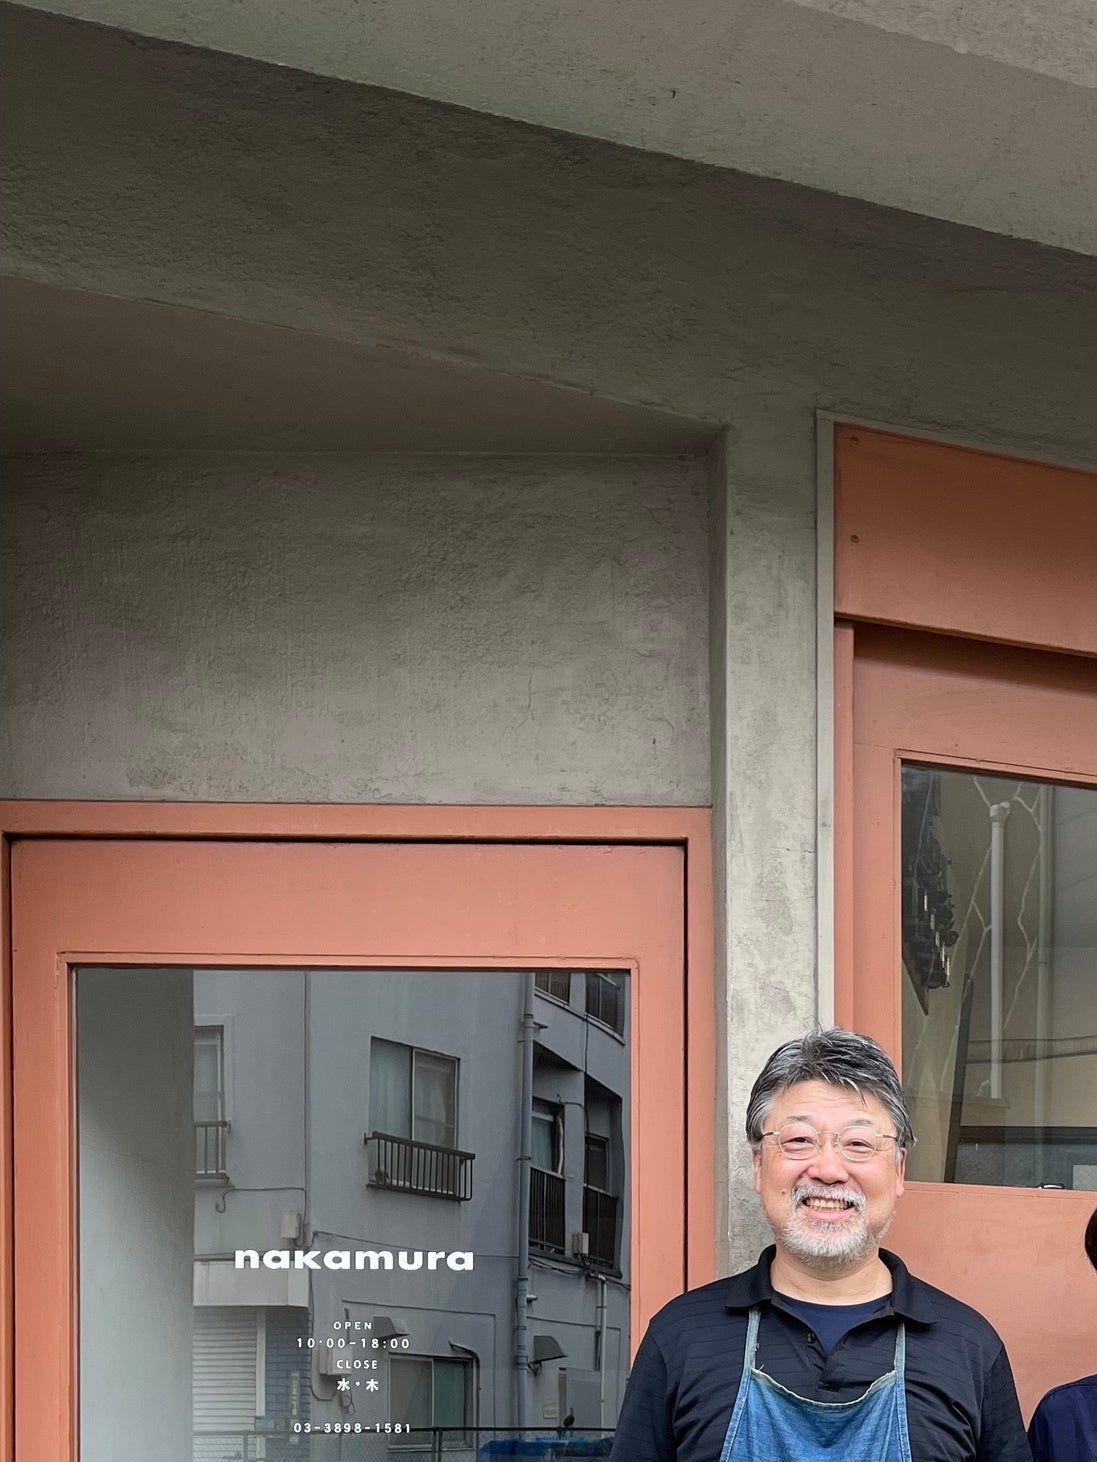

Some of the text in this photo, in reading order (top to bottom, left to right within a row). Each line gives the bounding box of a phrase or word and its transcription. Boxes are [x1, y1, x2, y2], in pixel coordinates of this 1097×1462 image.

[234, 1249, 475, 1271] nakamura
[333, 1321, 372, 1330] OPEN
[336, 1359, 378, 1370] CLOSE
[336, 1377, 379, 1392] 水・木
[293, 1422, 411, 1434] 03-3898-1581
